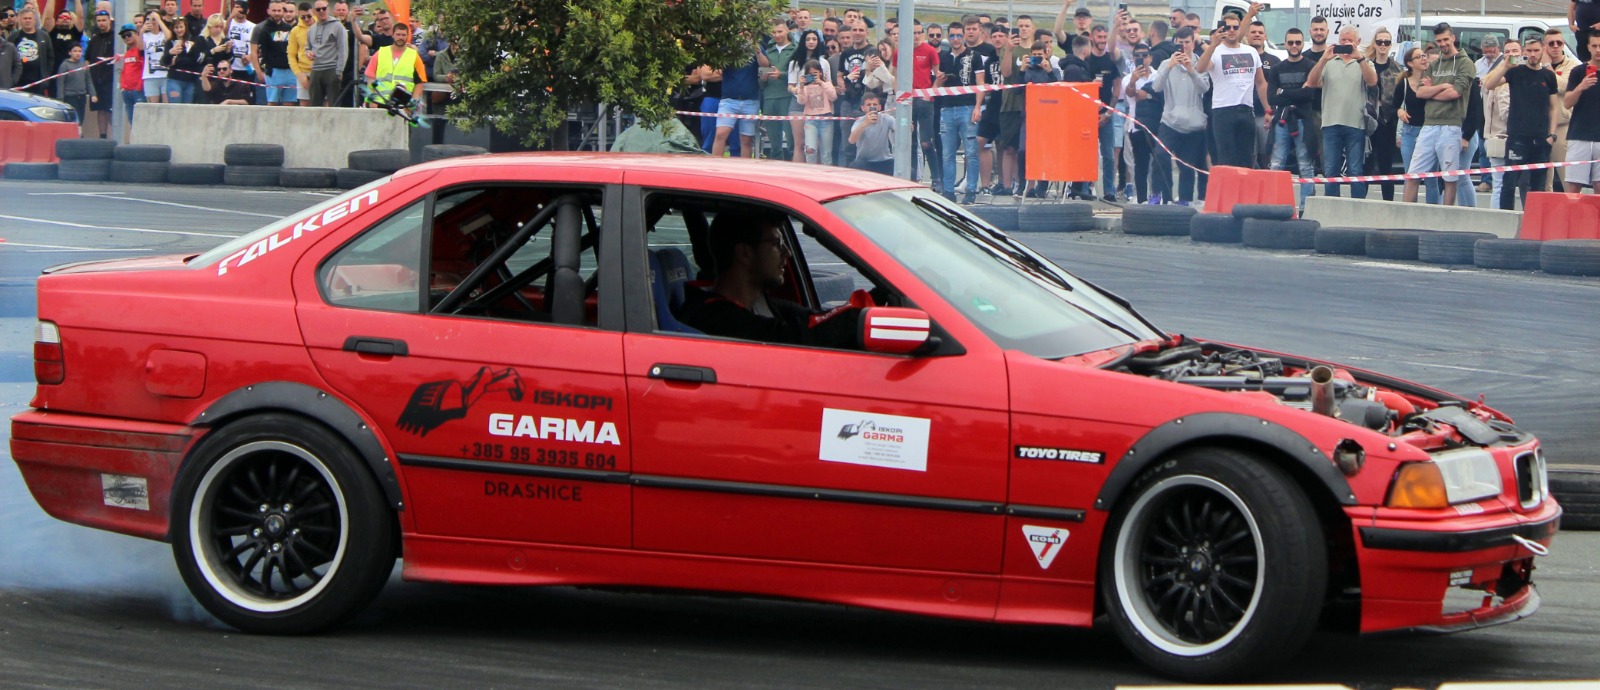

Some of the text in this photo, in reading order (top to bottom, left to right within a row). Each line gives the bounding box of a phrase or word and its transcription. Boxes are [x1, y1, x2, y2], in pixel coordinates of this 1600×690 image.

[1316, 3, 1382, 18] Exclusive Cars
[217, 189, 379, 276] FALKEN
[533, 389, 613, 411] ISKOPI
[488, 412, 621, 446] GARMA
[878, 426, 903, 434] ISKOPI
[460, 442, 616, 469] +385 95 3935 604
[1019, 447, 1101, 463] TOYO TIRES
[484, 480, 584, 501] DRASNICE
[1031, 535, 1060, 544] KONI
